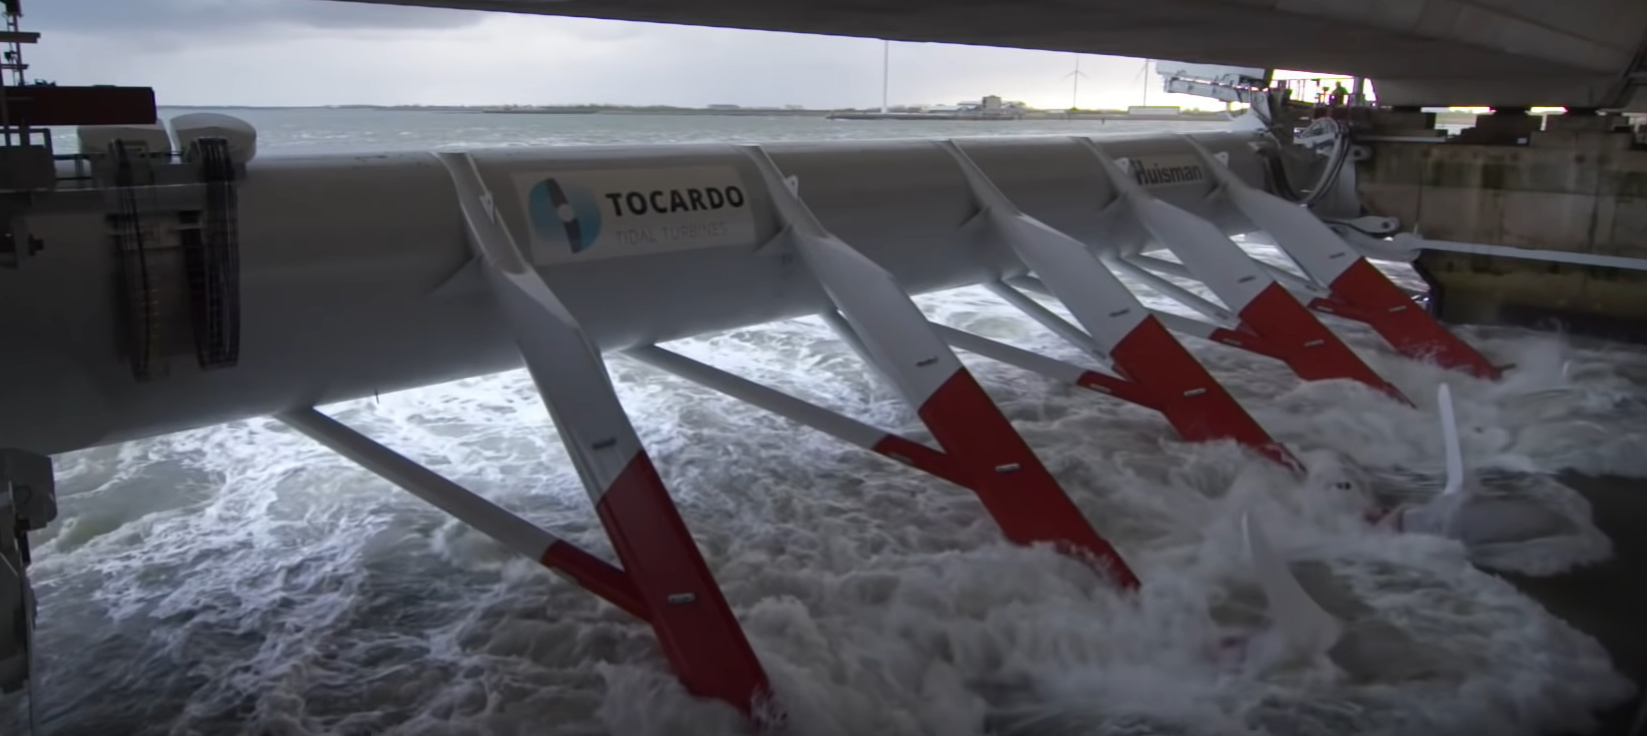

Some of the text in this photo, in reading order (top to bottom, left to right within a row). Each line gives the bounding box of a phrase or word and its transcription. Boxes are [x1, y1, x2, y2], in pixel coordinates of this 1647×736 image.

[1130, 159, 1202, 185] Huisman
[605, 185, 744, 217] TOCARDO
[616, 220, 728, 245] TIDAL TURBINES
